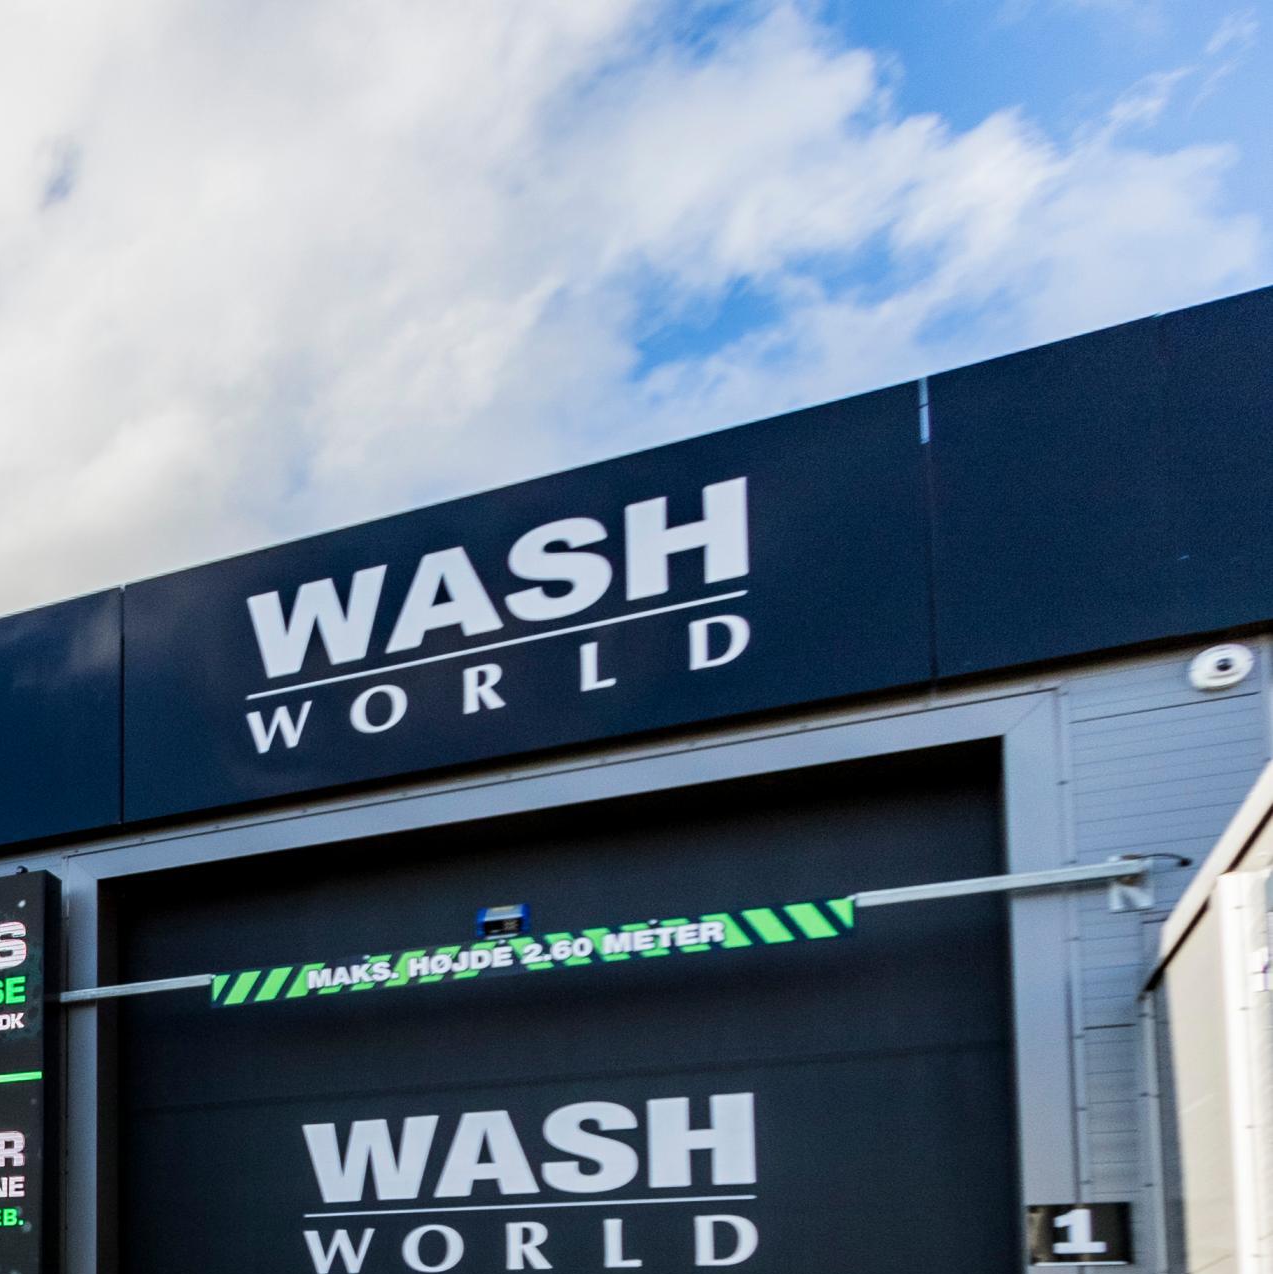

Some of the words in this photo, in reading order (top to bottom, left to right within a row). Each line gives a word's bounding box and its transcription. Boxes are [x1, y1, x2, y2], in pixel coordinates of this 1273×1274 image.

[246, 475, 750, 680] WASH
[245, 613, 751, 755] WORLD
[307, 959, 399, 990] MAKS.
[408, 945, 513, 978] HØJDE
[520, 937, 594, 965] 2.60
[602, 921, 725, 955] METER
[302, 1091, 758, 1204] WASH
[1053, 1208, 1107, 1254] 1
